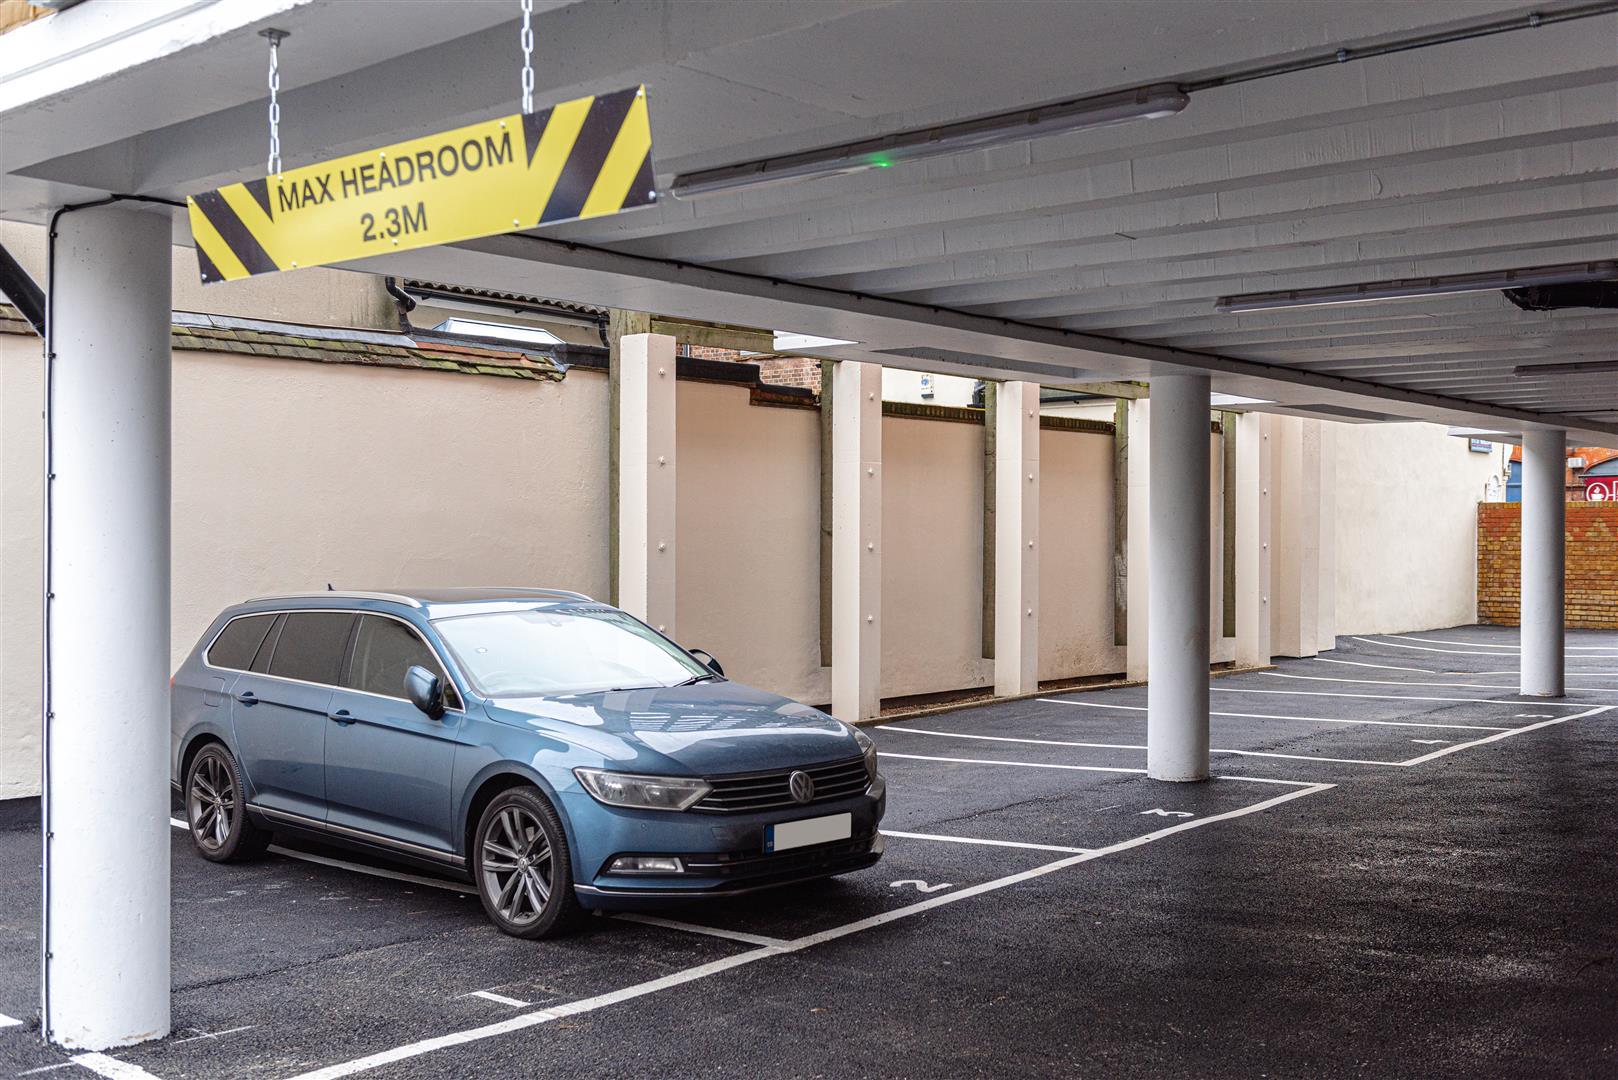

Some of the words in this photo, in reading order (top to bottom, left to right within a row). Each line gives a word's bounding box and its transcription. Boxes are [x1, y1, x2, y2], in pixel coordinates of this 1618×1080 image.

[277, 174, 335, 212] MAX
[340, 131, 514, 199] HEADROOM
[360, 201, 428, 242] 2.3M
[889, 879, 953, 893] 2
